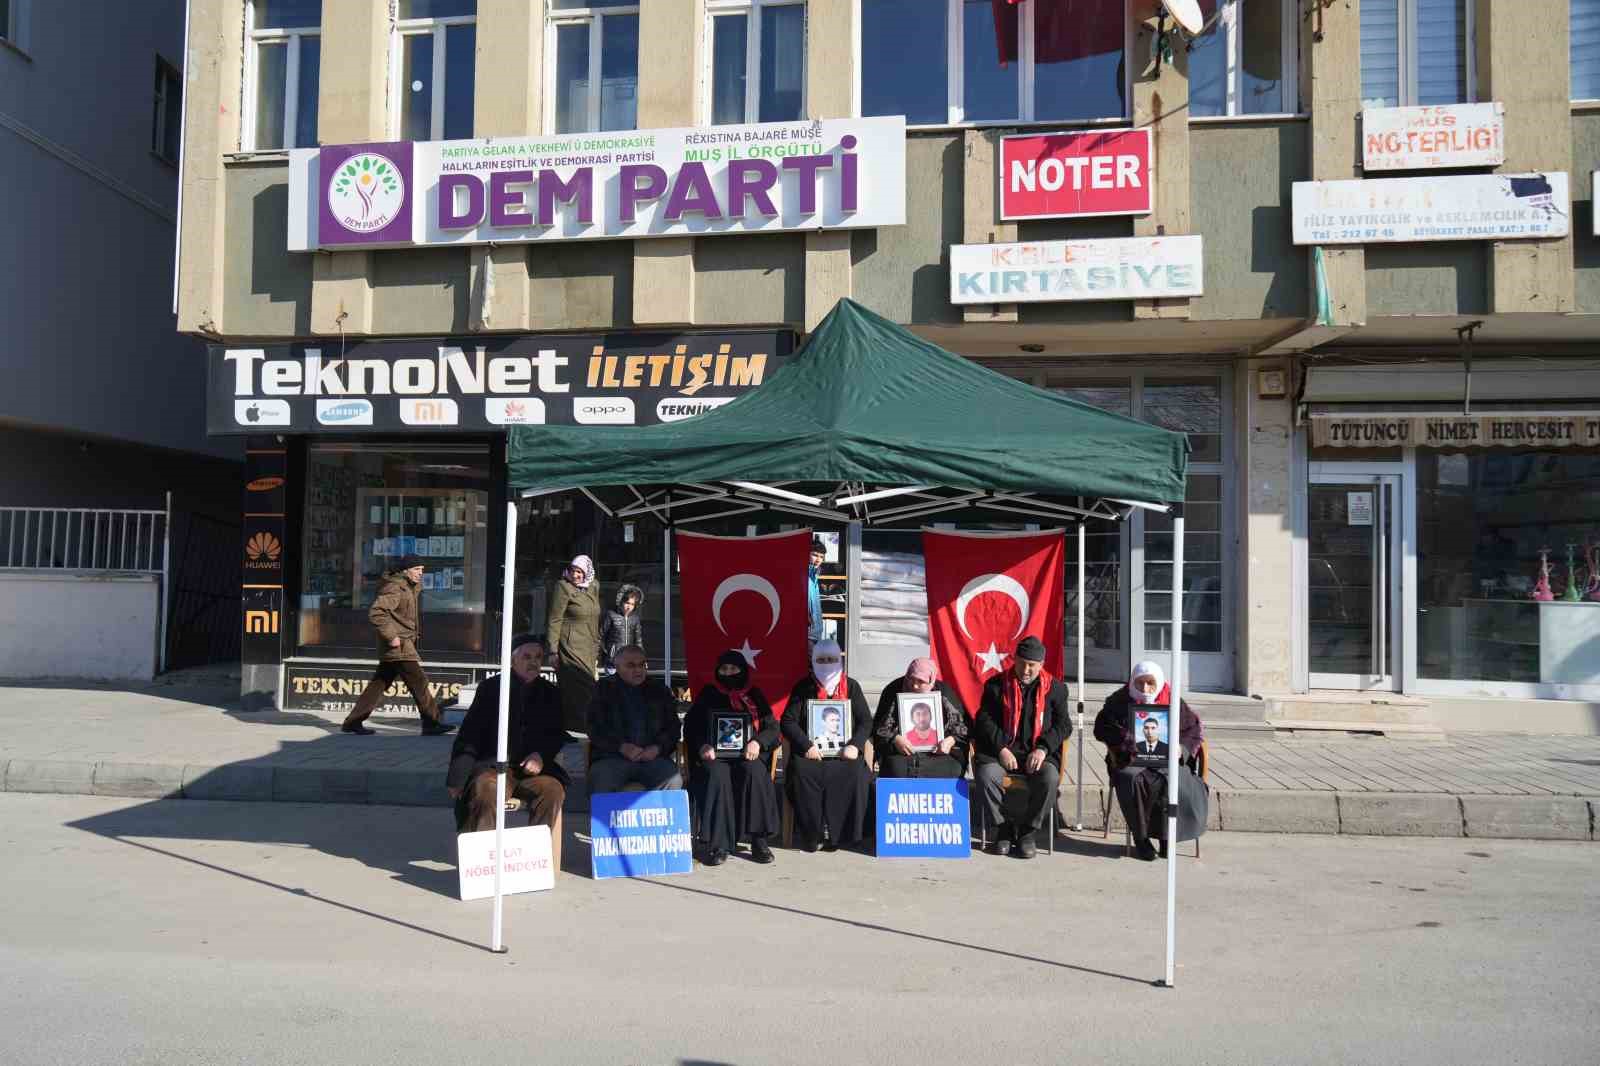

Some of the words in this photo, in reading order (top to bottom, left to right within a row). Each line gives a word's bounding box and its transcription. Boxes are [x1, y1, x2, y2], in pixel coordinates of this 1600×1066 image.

[540, 158, 552, 167] VE
[1011, 155, 1141, 192] NOTER
[438, 167, 593, 230] DEM
[620, 135, 857, 220] PARTİ
[224, 347, 570, 396] TeknoNet
[587, 344, 767, 396] İLETİŞİM
[245, 561, 280, 569] HUAWEI
[887, 792, 954, 814] ANNELER
[610, 809, 639, 828] ARTIK
[639, 808, 668, 827] YETER
[884, 817, 962, 845] DİRENİYOR
[488, 847, 523, 860] ELAT
